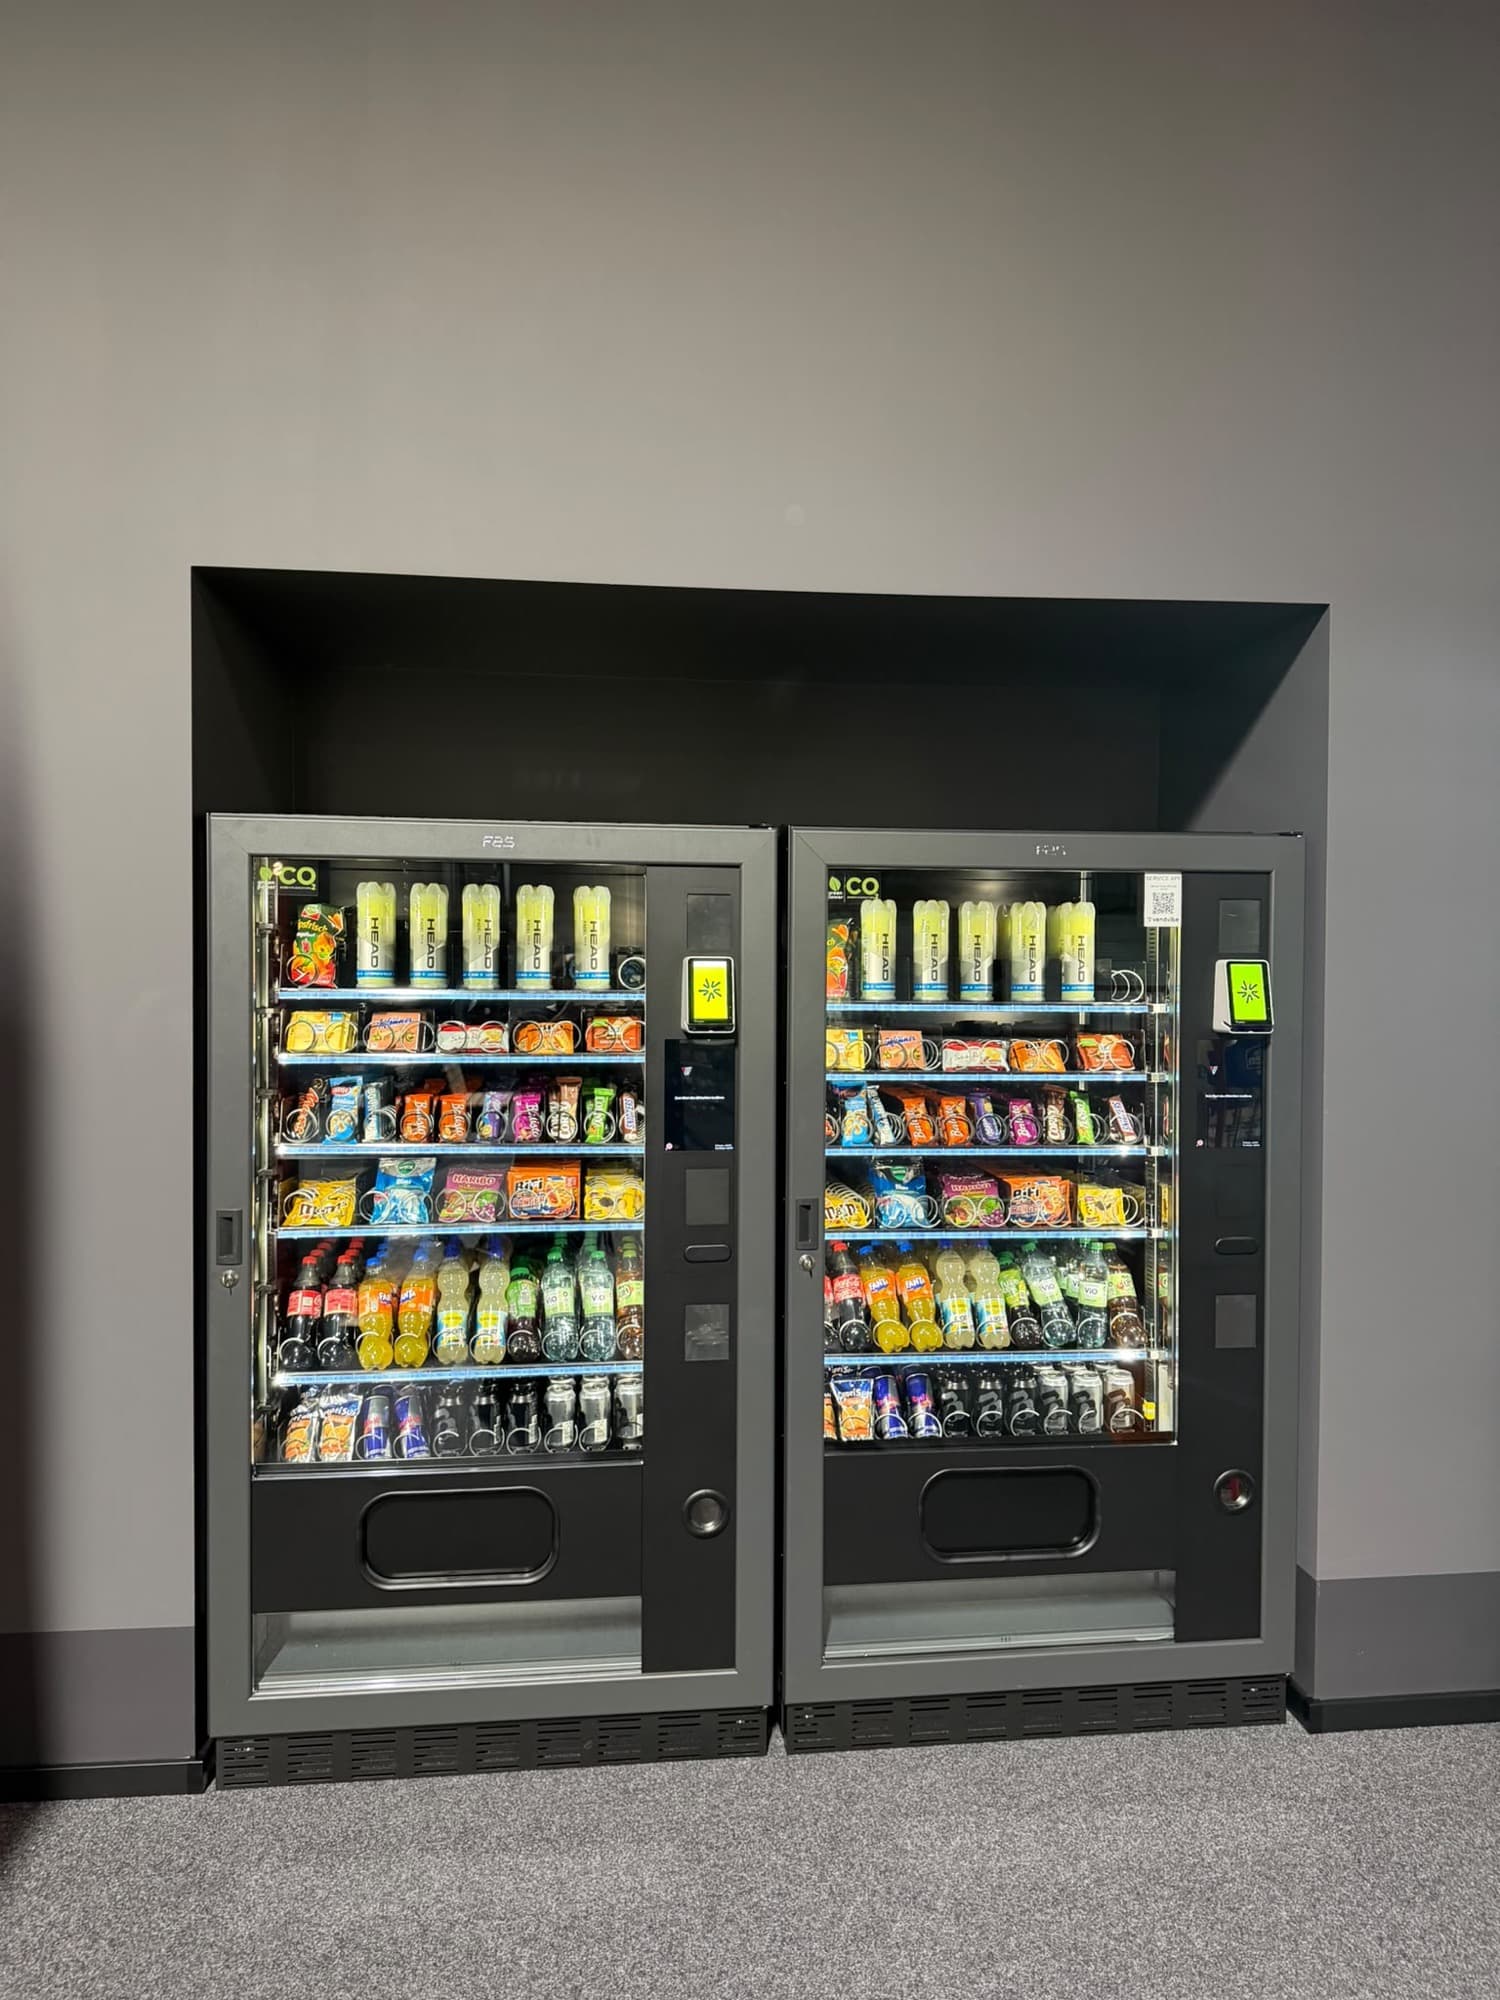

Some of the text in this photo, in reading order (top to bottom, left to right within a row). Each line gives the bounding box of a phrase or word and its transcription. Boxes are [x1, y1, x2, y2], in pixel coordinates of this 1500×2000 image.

[371, 917, 379, 968] HEAD
[427, 918, 435, 969] HEAD
[484, 919, 492, 969] HEAD
[533, 919, 541, 970] HEAD
[589, 920, 598, 970] HEAD
[973, 934, 981, 982] HEAD
[1028, 935, 1036, 983] HEAD
[452, 1173, 496, 1186] HARIBO
[514, 1177, 543, 1191] BiFi
[1085, 1287, 1097, 1295] ViO
